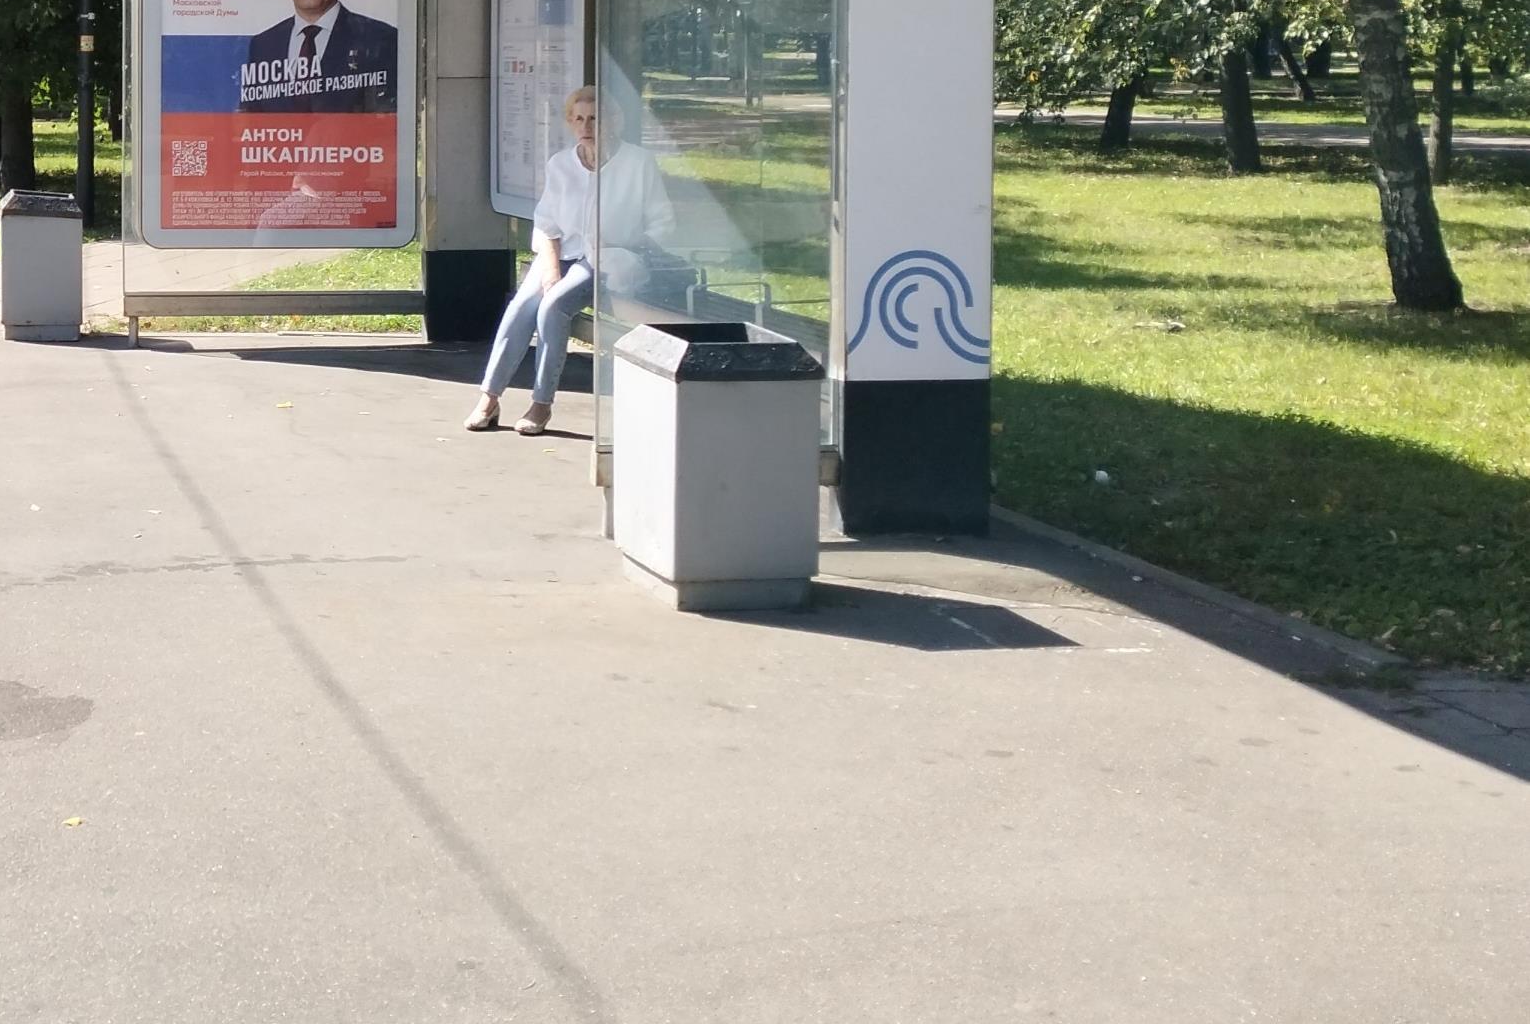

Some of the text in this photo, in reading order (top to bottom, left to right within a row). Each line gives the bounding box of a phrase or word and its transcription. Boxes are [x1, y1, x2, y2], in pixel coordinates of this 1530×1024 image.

[217, 8, 239, 17] Думы
[240, 55, 322, 86] МОСКВА
[240, 70, 387, 103] КОСМИЧЕСКОЕ РАЗВИТИЕ!
[240, 128, 303, 142] АНТОН
[240, 146, 384, 163] ШКАПЛЕРОВ
